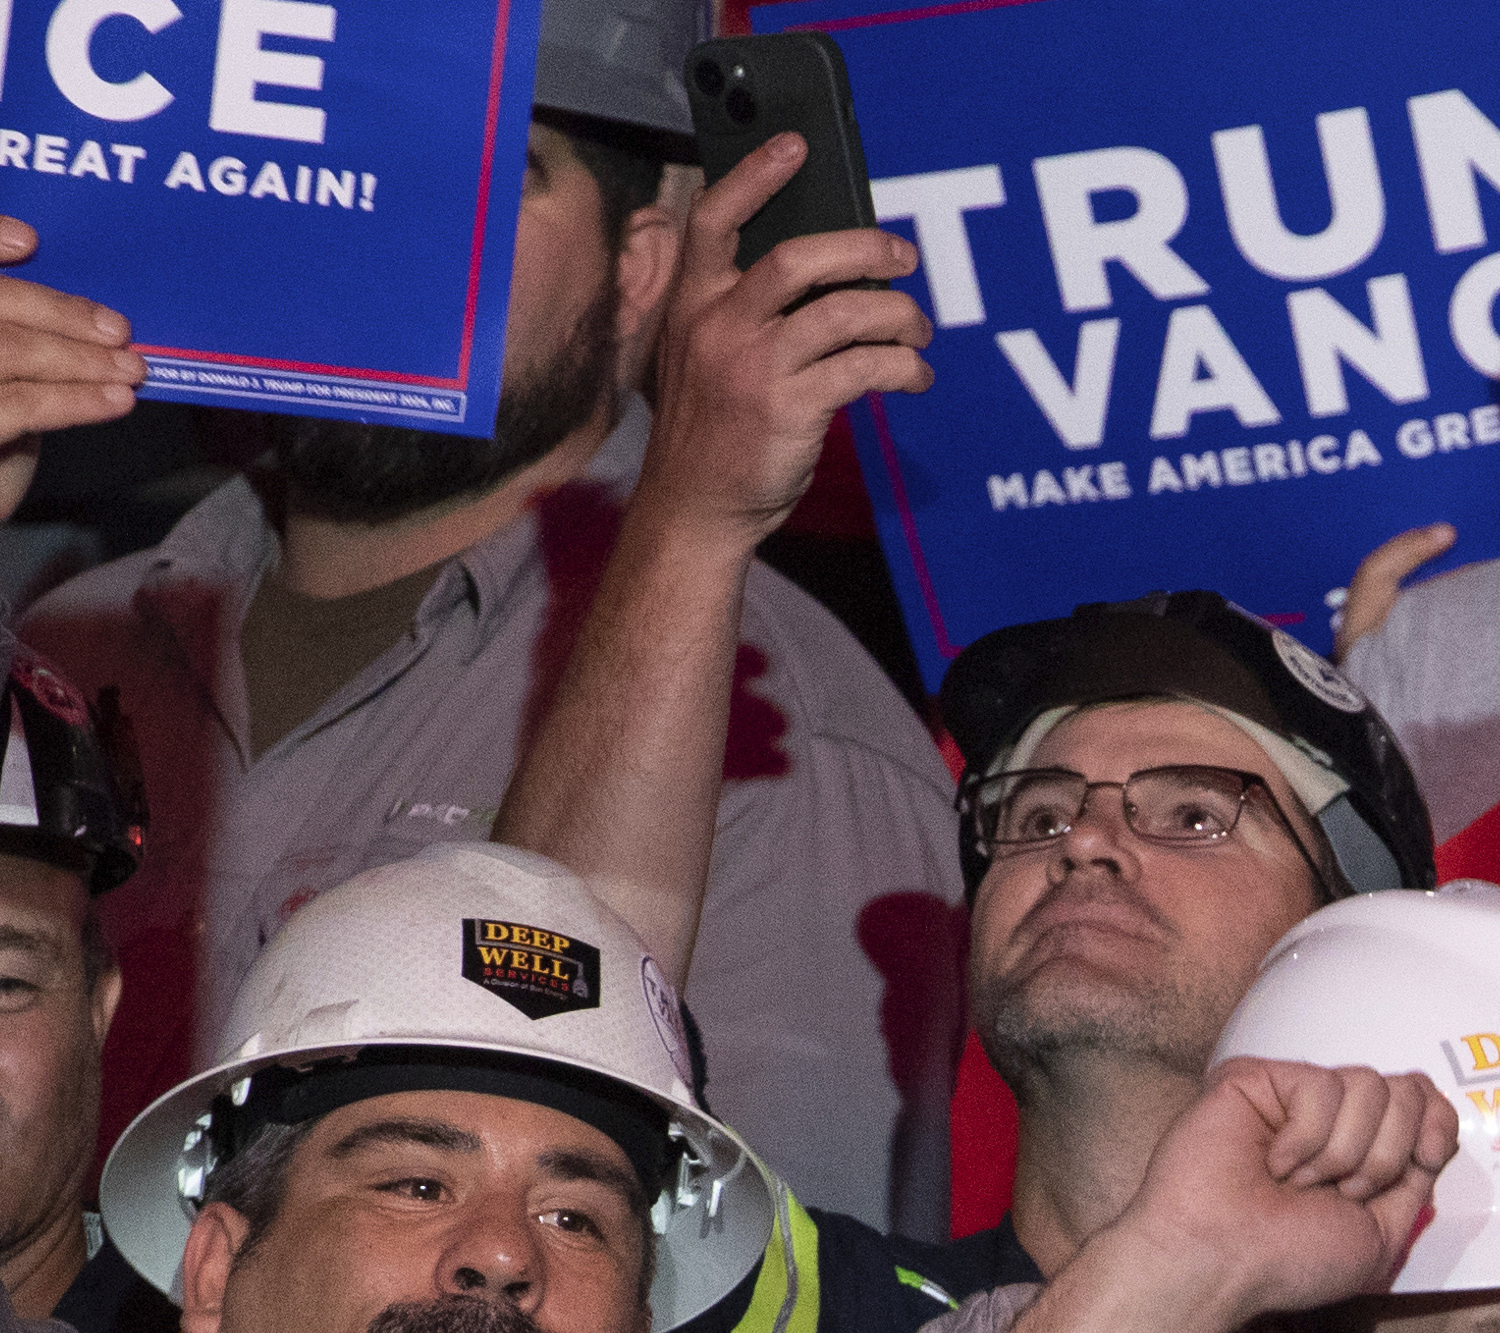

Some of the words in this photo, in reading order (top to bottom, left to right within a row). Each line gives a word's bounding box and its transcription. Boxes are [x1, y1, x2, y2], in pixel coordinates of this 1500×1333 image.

[164, 151, 377, 212] AGAIN!
[986, 459, 1132, 513] MAKE
[1148, 429, 1383, 495] AMERICA
[485, 922, 570, 954] DEEP
[478, 947, 569, 980] WELL
[483, 967, 569, 992] SERVICES
